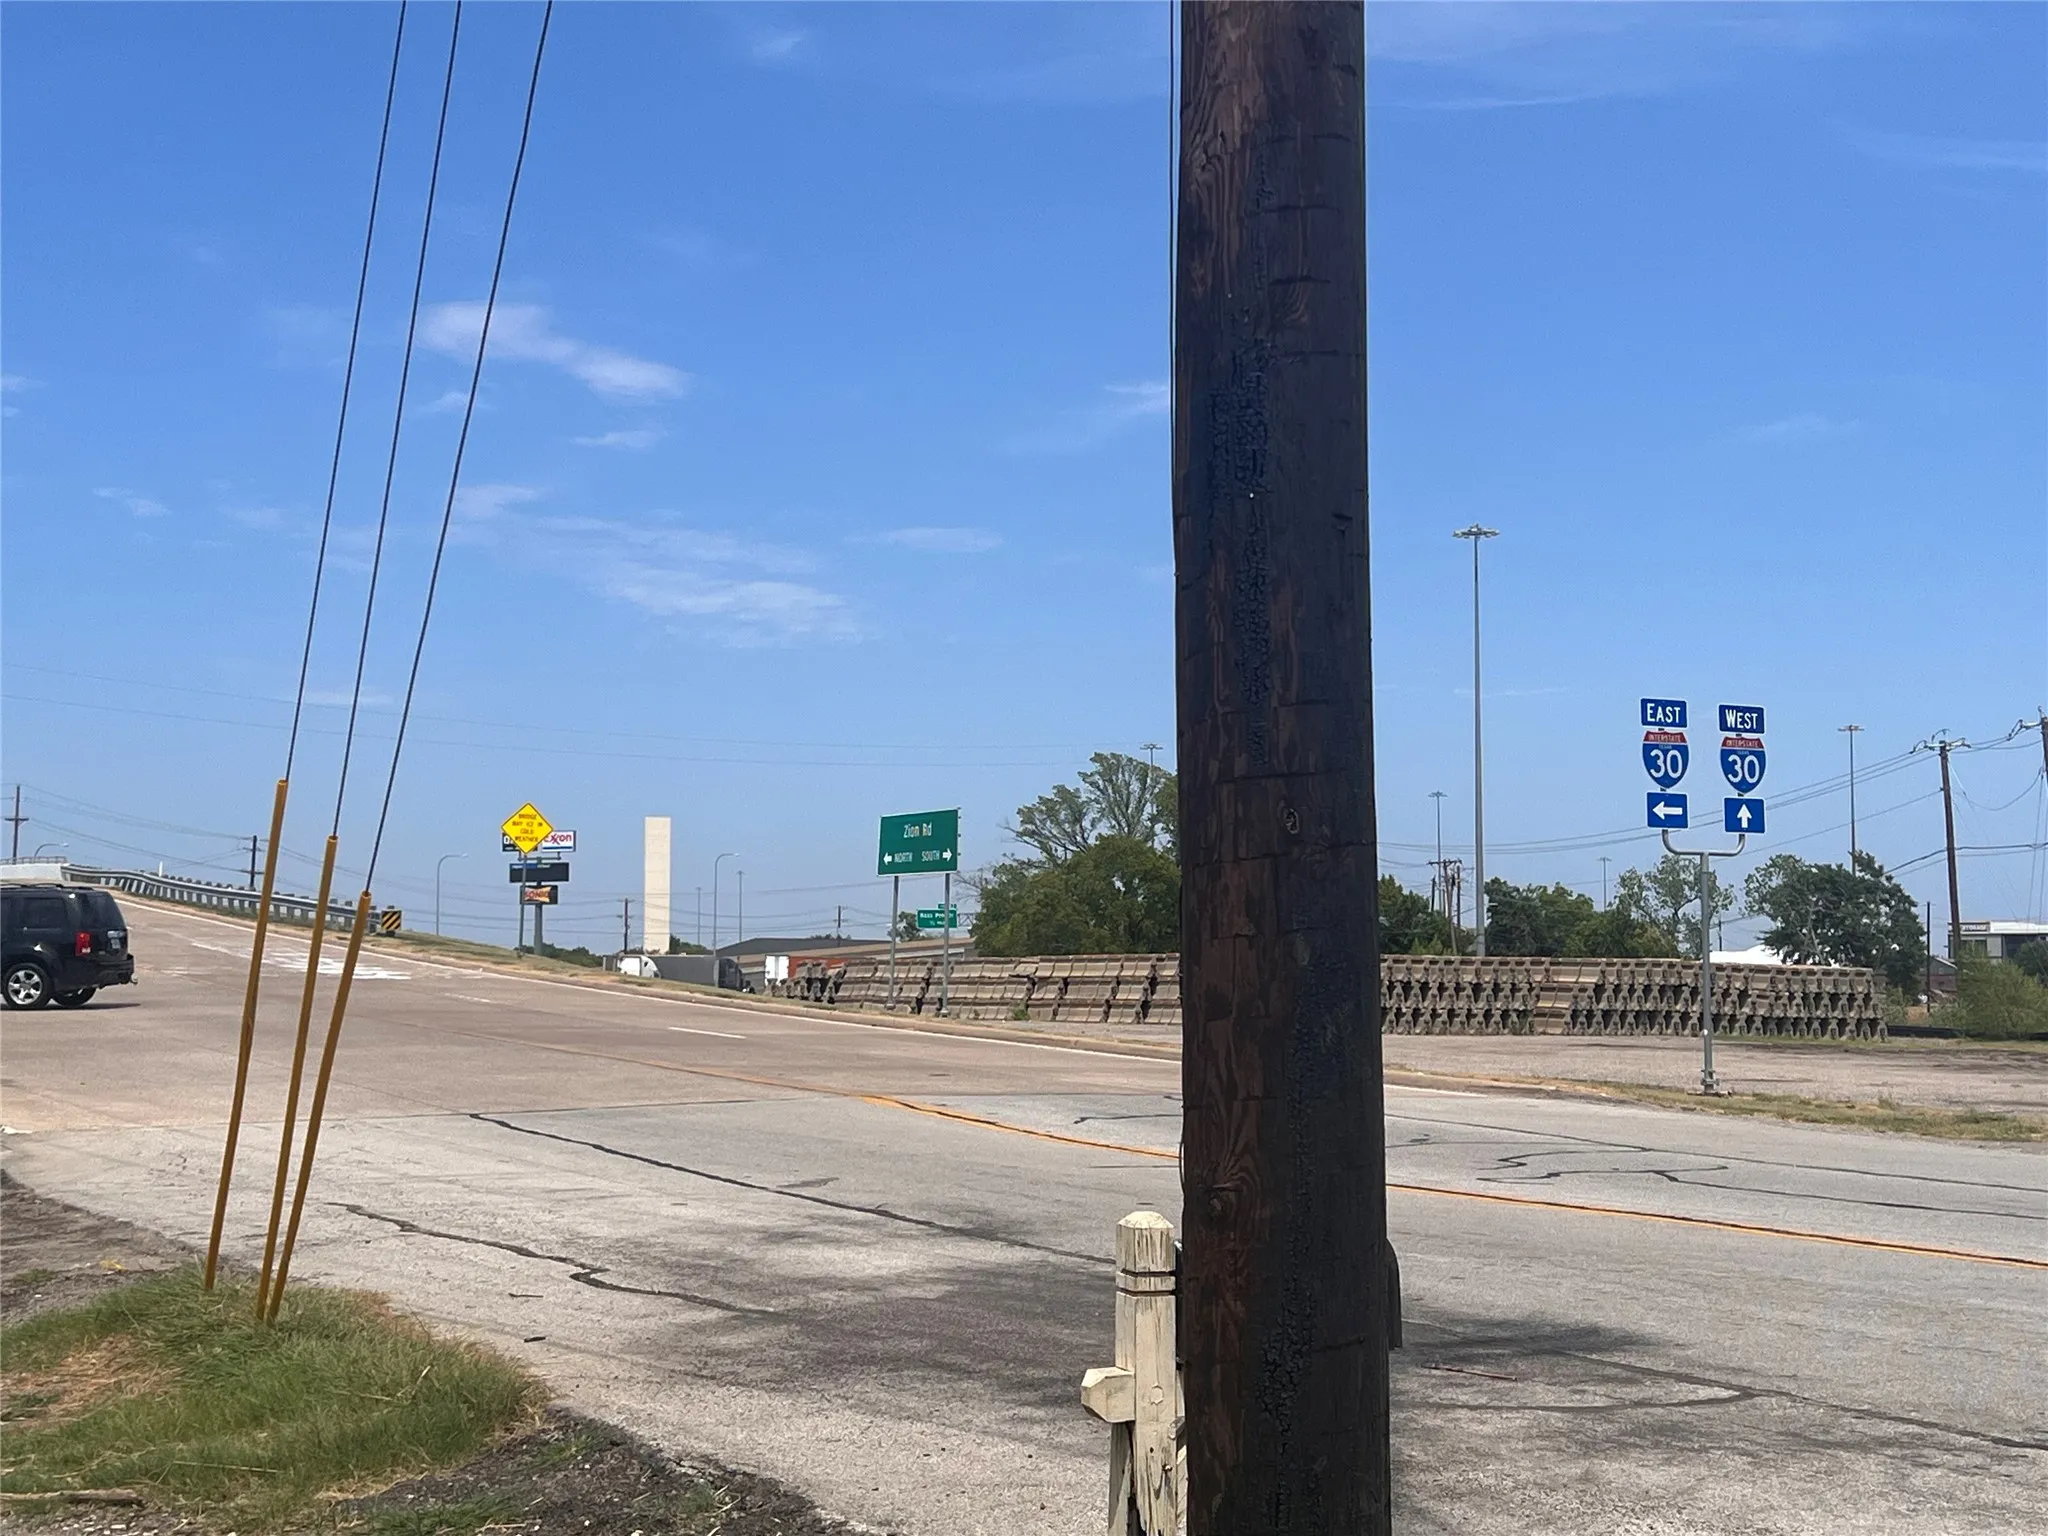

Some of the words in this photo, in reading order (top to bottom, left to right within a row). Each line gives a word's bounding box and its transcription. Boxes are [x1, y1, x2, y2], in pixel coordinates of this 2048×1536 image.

[1646, 703, 1681, 723] EAST
[1725, 709, 1758, 729] WEST
[1648, 734, 1682, 743] INTERSTATE
[1726, 739, 1759, 748] INTERSTATE
[1649, 749, 1683, 779] 30
[1727, 754, 1760, 784] 30
[903, 823, 920, 839] Zion
[922, 822, 932, 836] Rd
[894, 852, 913, 863] NORTH
[921, 849, 940, 862] SOUTH
